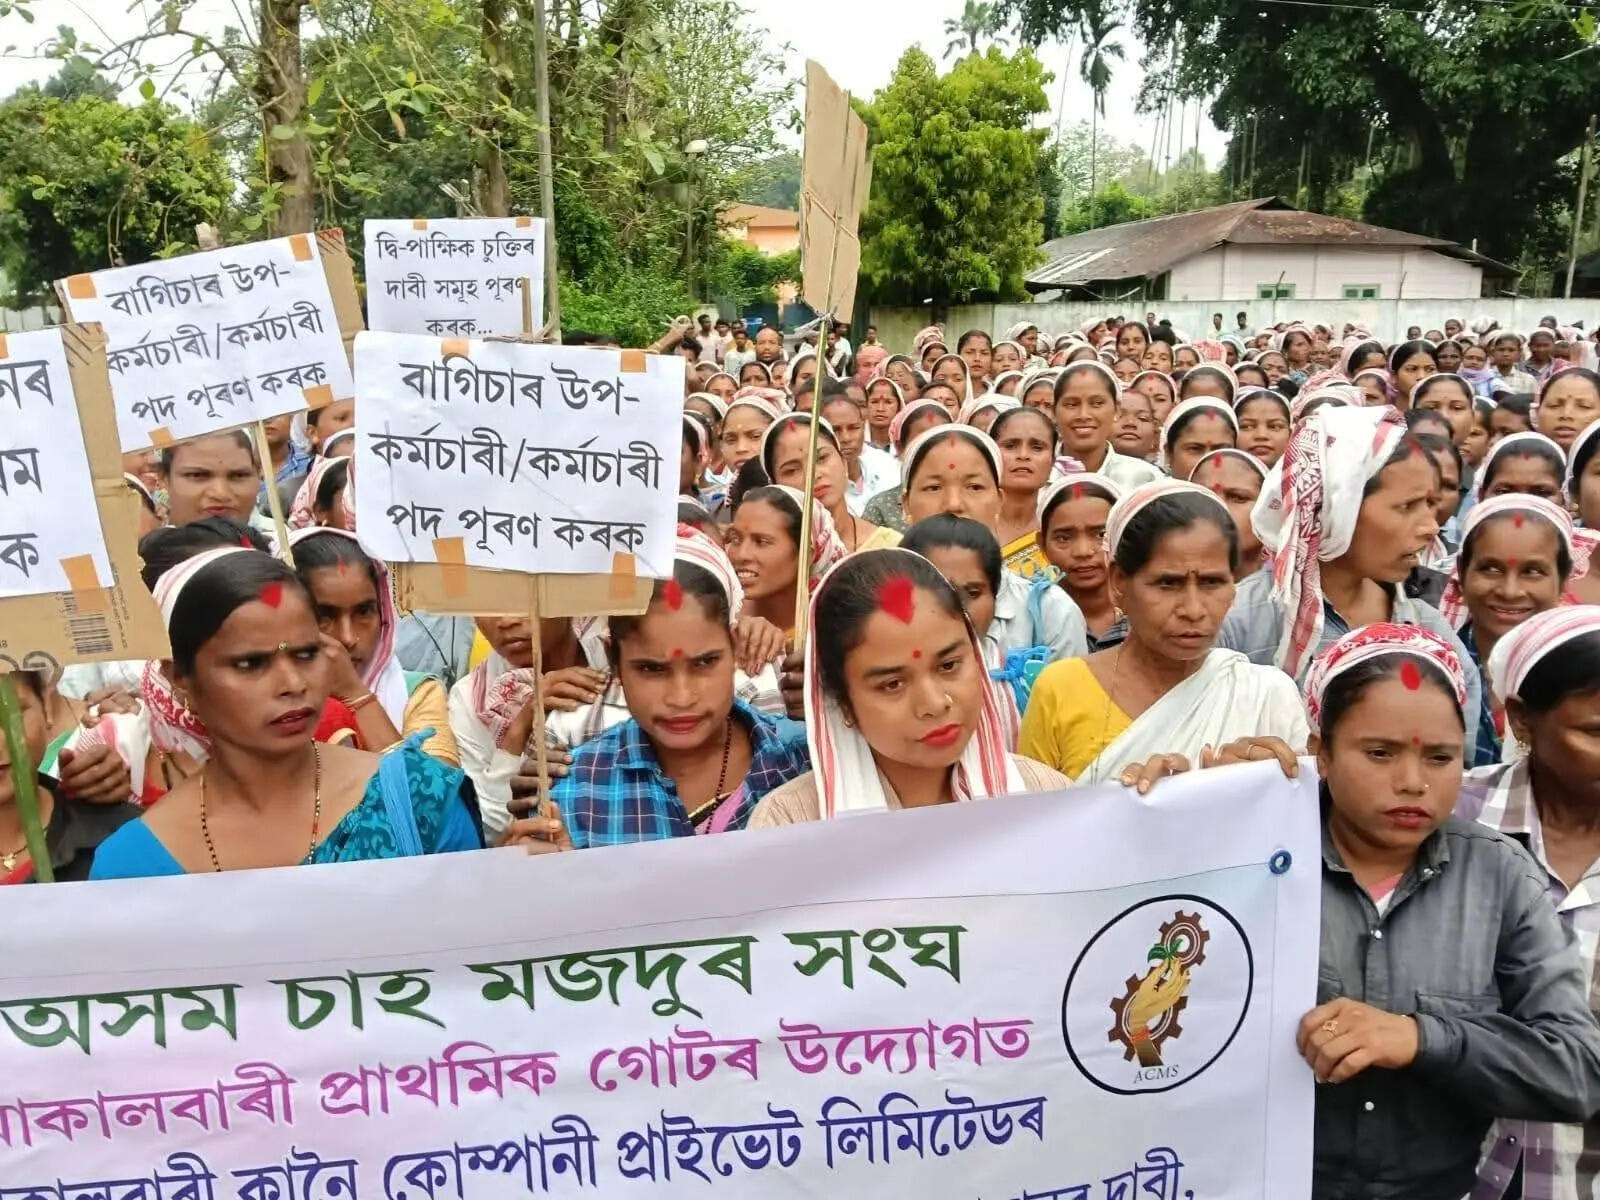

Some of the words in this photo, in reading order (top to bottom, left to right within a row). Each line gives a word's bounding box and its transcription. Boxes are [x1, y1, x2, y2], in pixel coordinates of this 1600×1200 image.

[375, 231, 474, 259] দ্বি-পাক্ষিক
[482, 231, 535, 262] চুক্তিৰ
[106, 275, 223, 316] বাগিচাৰ
[220, 259, 291, 293] উপ-
[384, 273, 426, 299] দাবী
[434, 280, 478, 302] সমূহ
[132, 396, 176, 423] পদ
[187, 378, 253, 417] পূৰণ
[257, 362, 327, 396] কৰক
[399, 355, 545, 408] বাগিচাৰ
[551, 360, 640, 416] উপ-
[368, 423, 664, 489] কৰ্মচাৰী/কৰ্মচাৰী
[387, 501, 444, 537] পদ
[458, 506, 541, 554] পূৰণ
[552, 518, 647, 552] কৰক
[0, 984, 244, 1055] অসম
[267, 968, 446, 1030] চাহ
[463, 936, 759, 1019] মজদুৰ
[782, 926, 967, 989] সংঘ
[0, 1062, 298, 1147] াকালবাৰী
[590, 1024, 762, 1091] গোটৰ
[777, 1017, 1034, 1074] উদ্যোগত
[1133, 1064, 1179, 1084] ACMS
[384, 1115, 599, 1200] কোম্পানী
[816, 1089, 1047, 1168] লিমিটেডৰ
